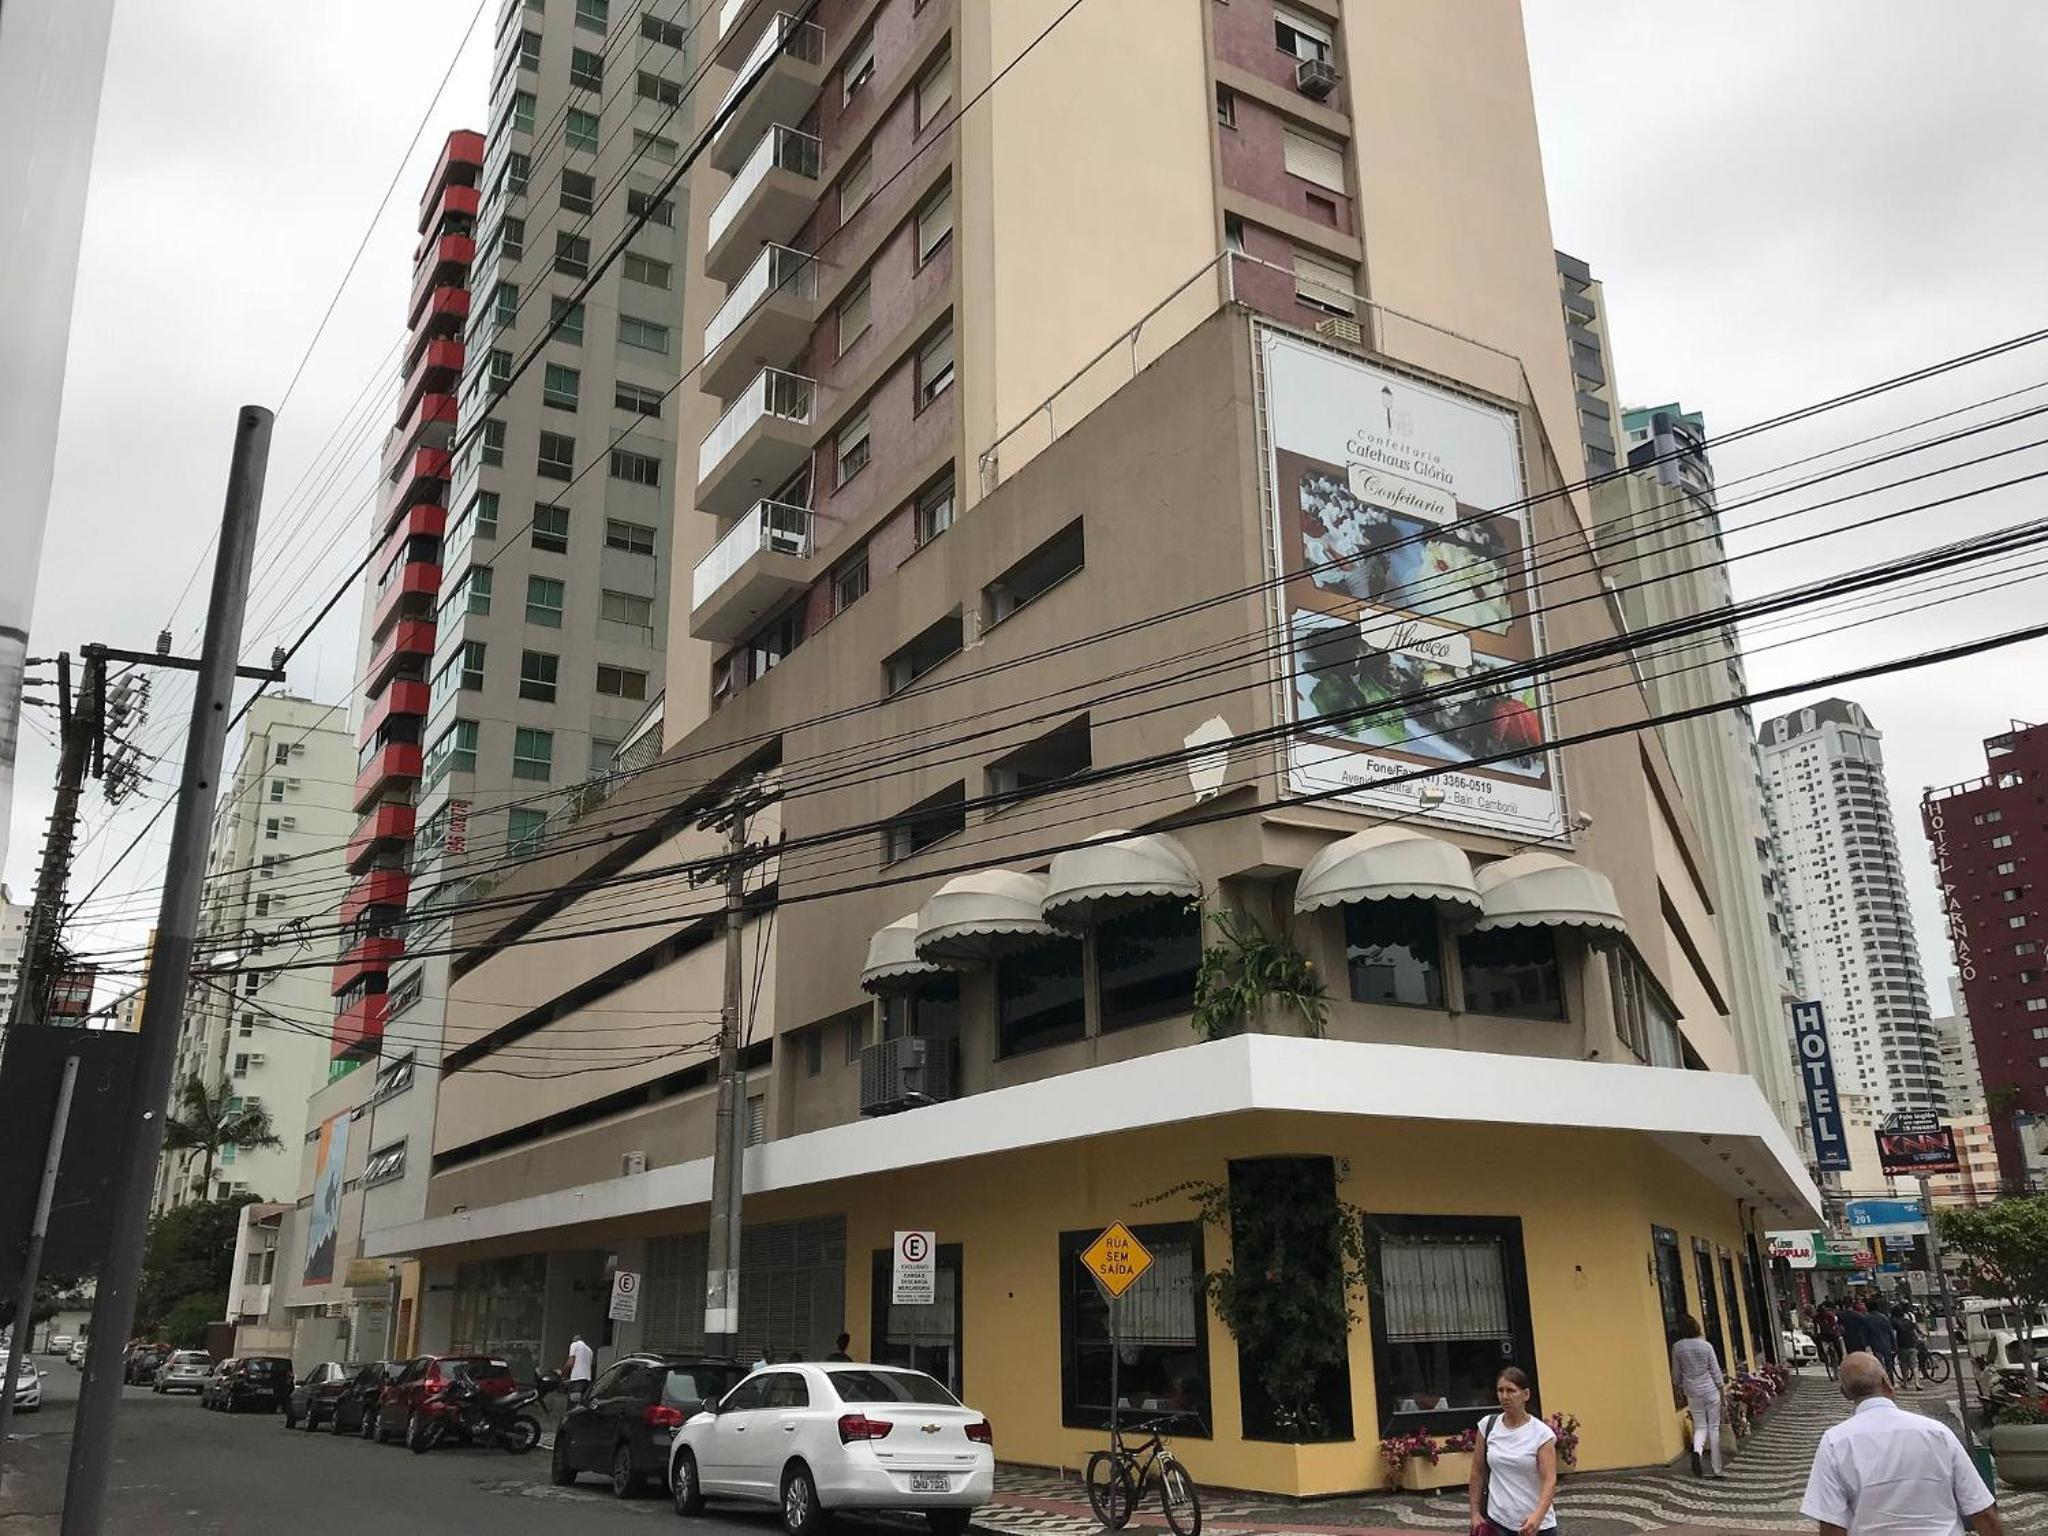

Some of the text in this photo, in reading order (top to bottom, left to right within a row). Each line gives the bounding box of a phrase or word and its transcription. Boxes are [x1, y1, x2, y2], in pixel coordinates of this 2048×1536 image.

[1357, 428, 1441, 463] Confeitaria
[1413, 460, 1454, 485] Glória
[1358, 469, 1445, 514] Confeitaria
[1341, 768, 1379, 789] Avenid
[1927, 801, 1977, 981] HOTEL PARNASO
[1796, 1006, 1839, 1142] HOTEL
[1855, 1214, 1872, 1224] 201
[910, 1239, 920, 1257] E
[1106, 1238, 1129, 1249] RUA
[1106, 1251, 1129, 1262] SEM
[1100, 1264, 1135, 1276] SAÍDA
[623, 1277, 631, 1290] E
